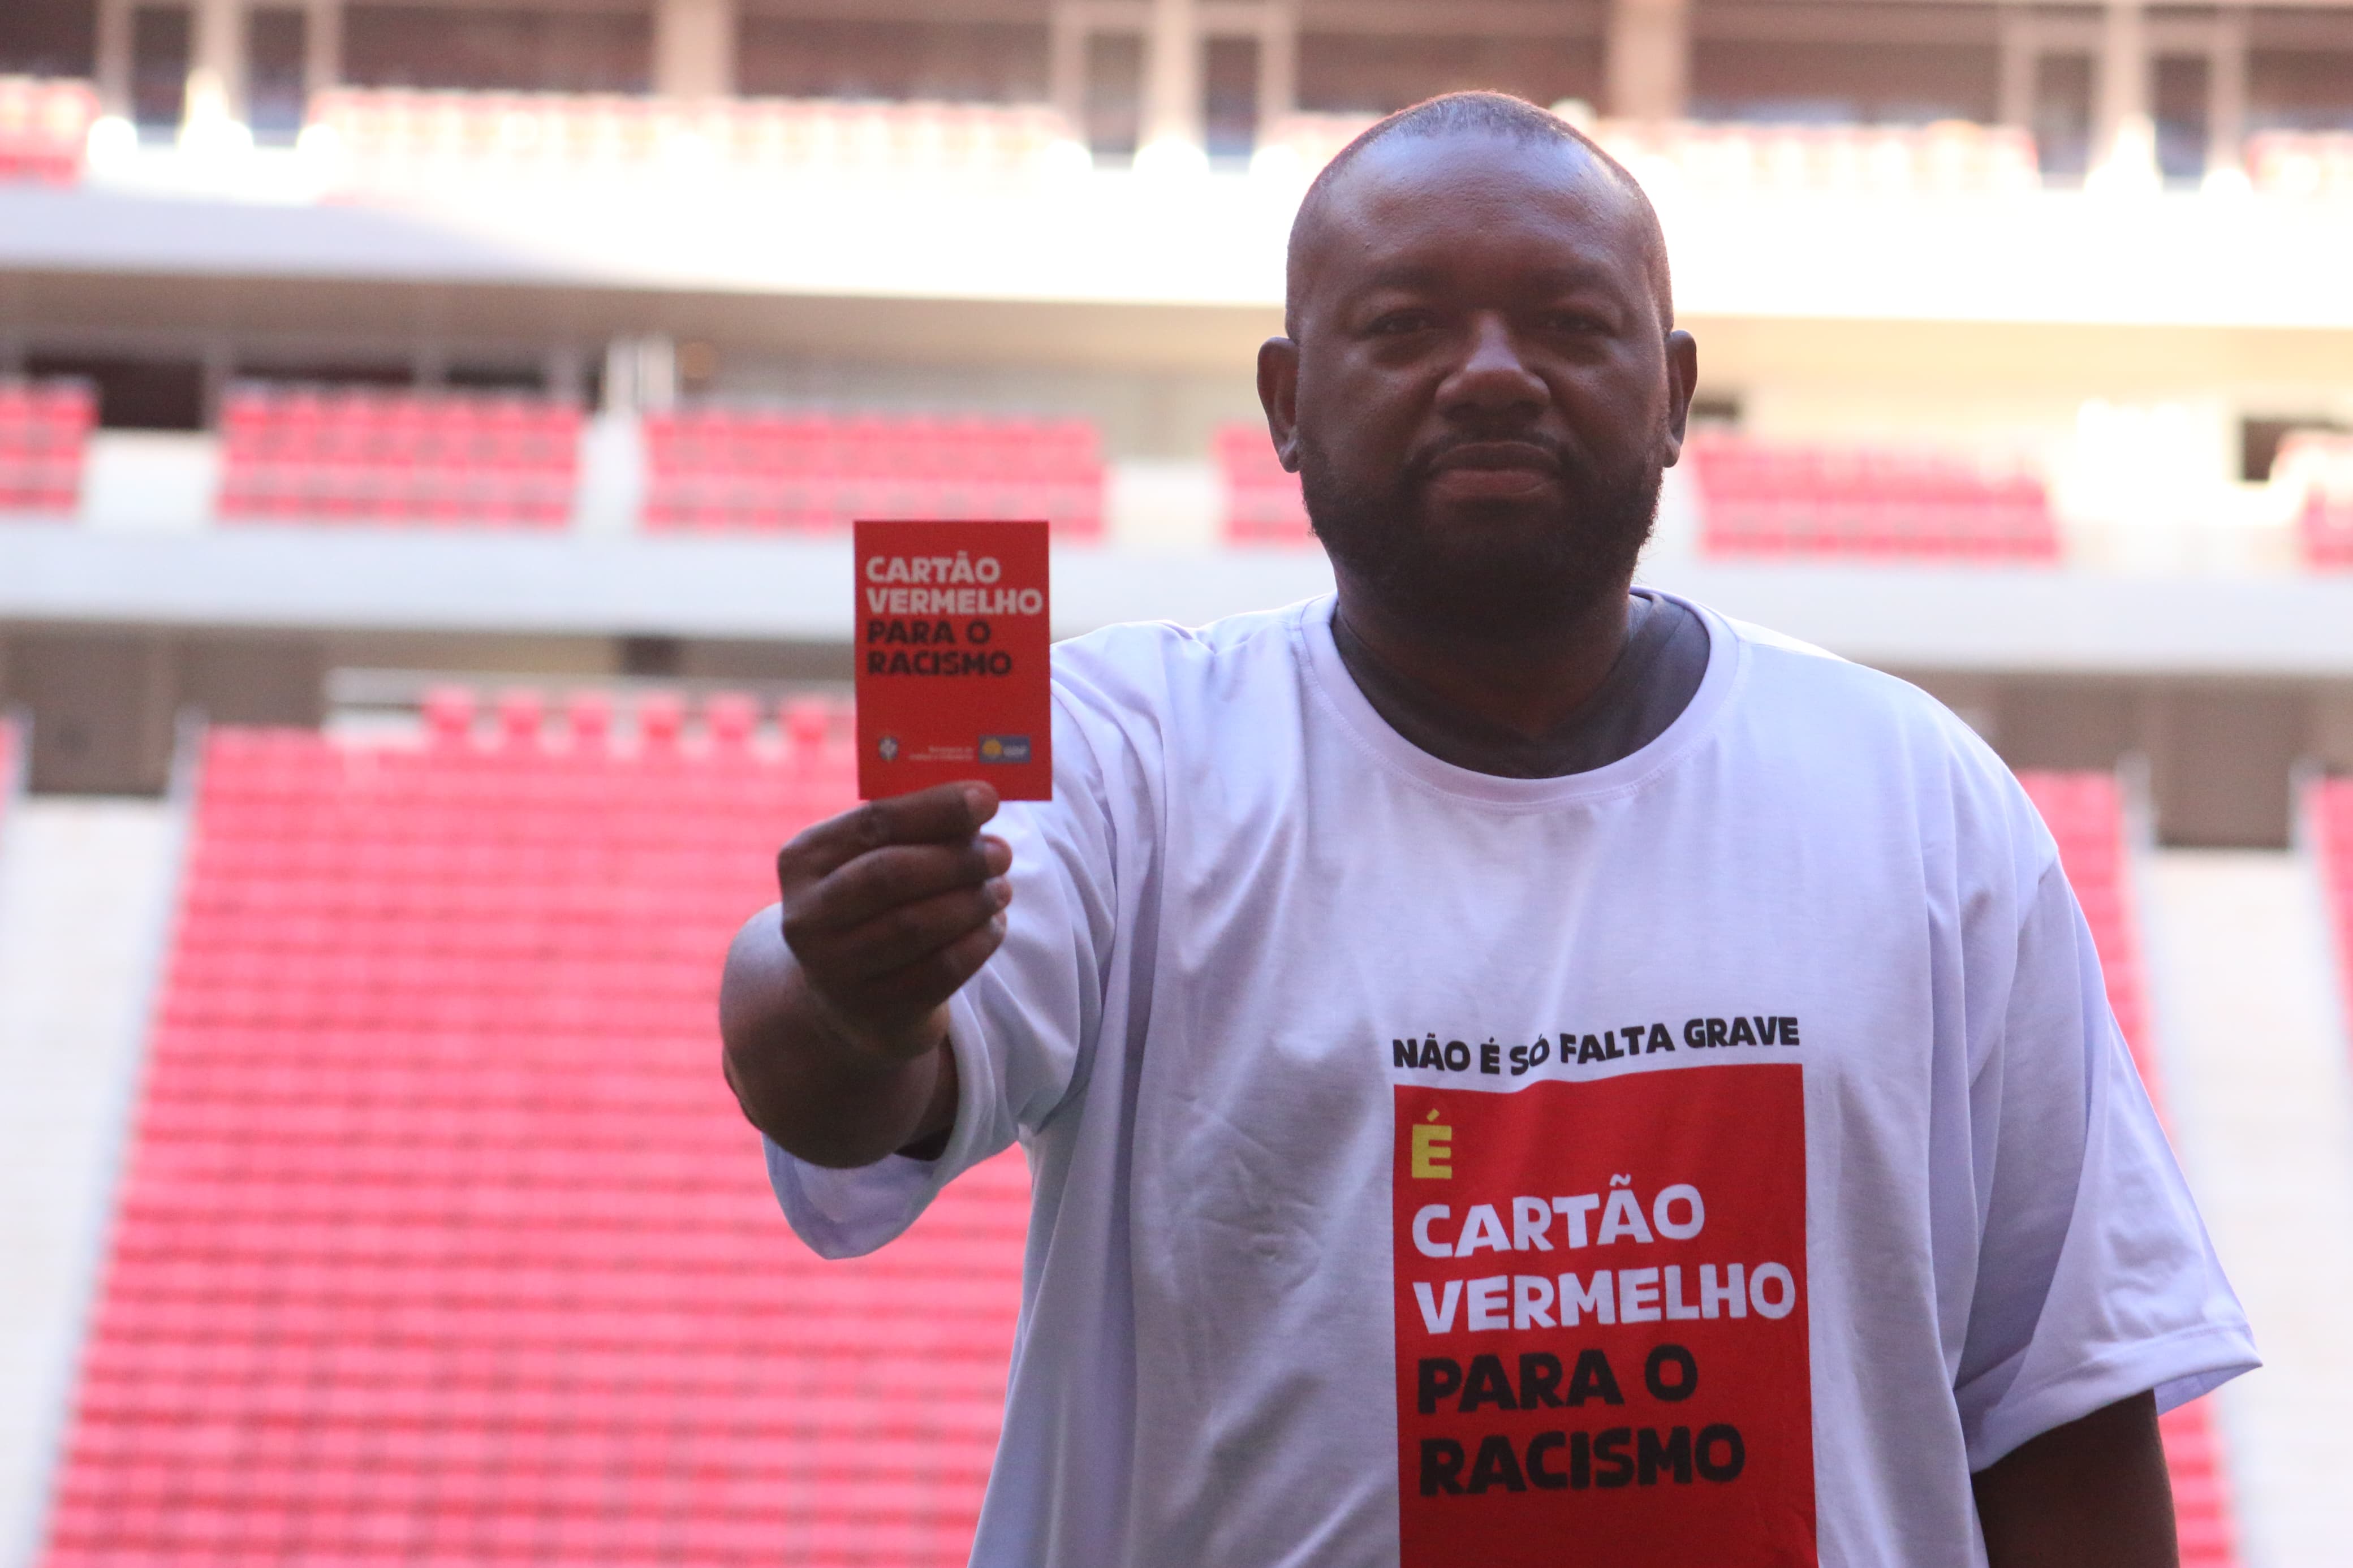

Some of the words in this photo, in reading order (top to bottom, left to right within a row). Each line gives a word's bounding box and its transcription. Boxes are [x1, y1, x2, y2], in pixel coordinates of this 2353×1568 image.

[866, 551, 1002, 584] CARTÃO
[866, 588, 1043, 615] VERMELHO
[867, 619, 956, 644] PARA
[966, 619, 992, 644] O
[867, 651, 1012, 676] RACISMO
[1393, 1033, 1471, 1071] NÃO
[1480, 1037, 1500, 1074] É
[1510, 1034, 1550, 1075] SÓ
[1559, 1023, 1675, 1064] FALTA
[1683, 1016, 1799, 1048] GRAVE
[1411, 1108, 1453, 1179] É
[1412, 1173, 1705, 1258] CARTÃO
[1412, 1262, 1795, 1334] VERMELHO
[1417, 1349, 1625, 1415] PARA
[1644, 1344, 1697, 1402] O
[1419, 1423, 1745, 1497] RACISMO
